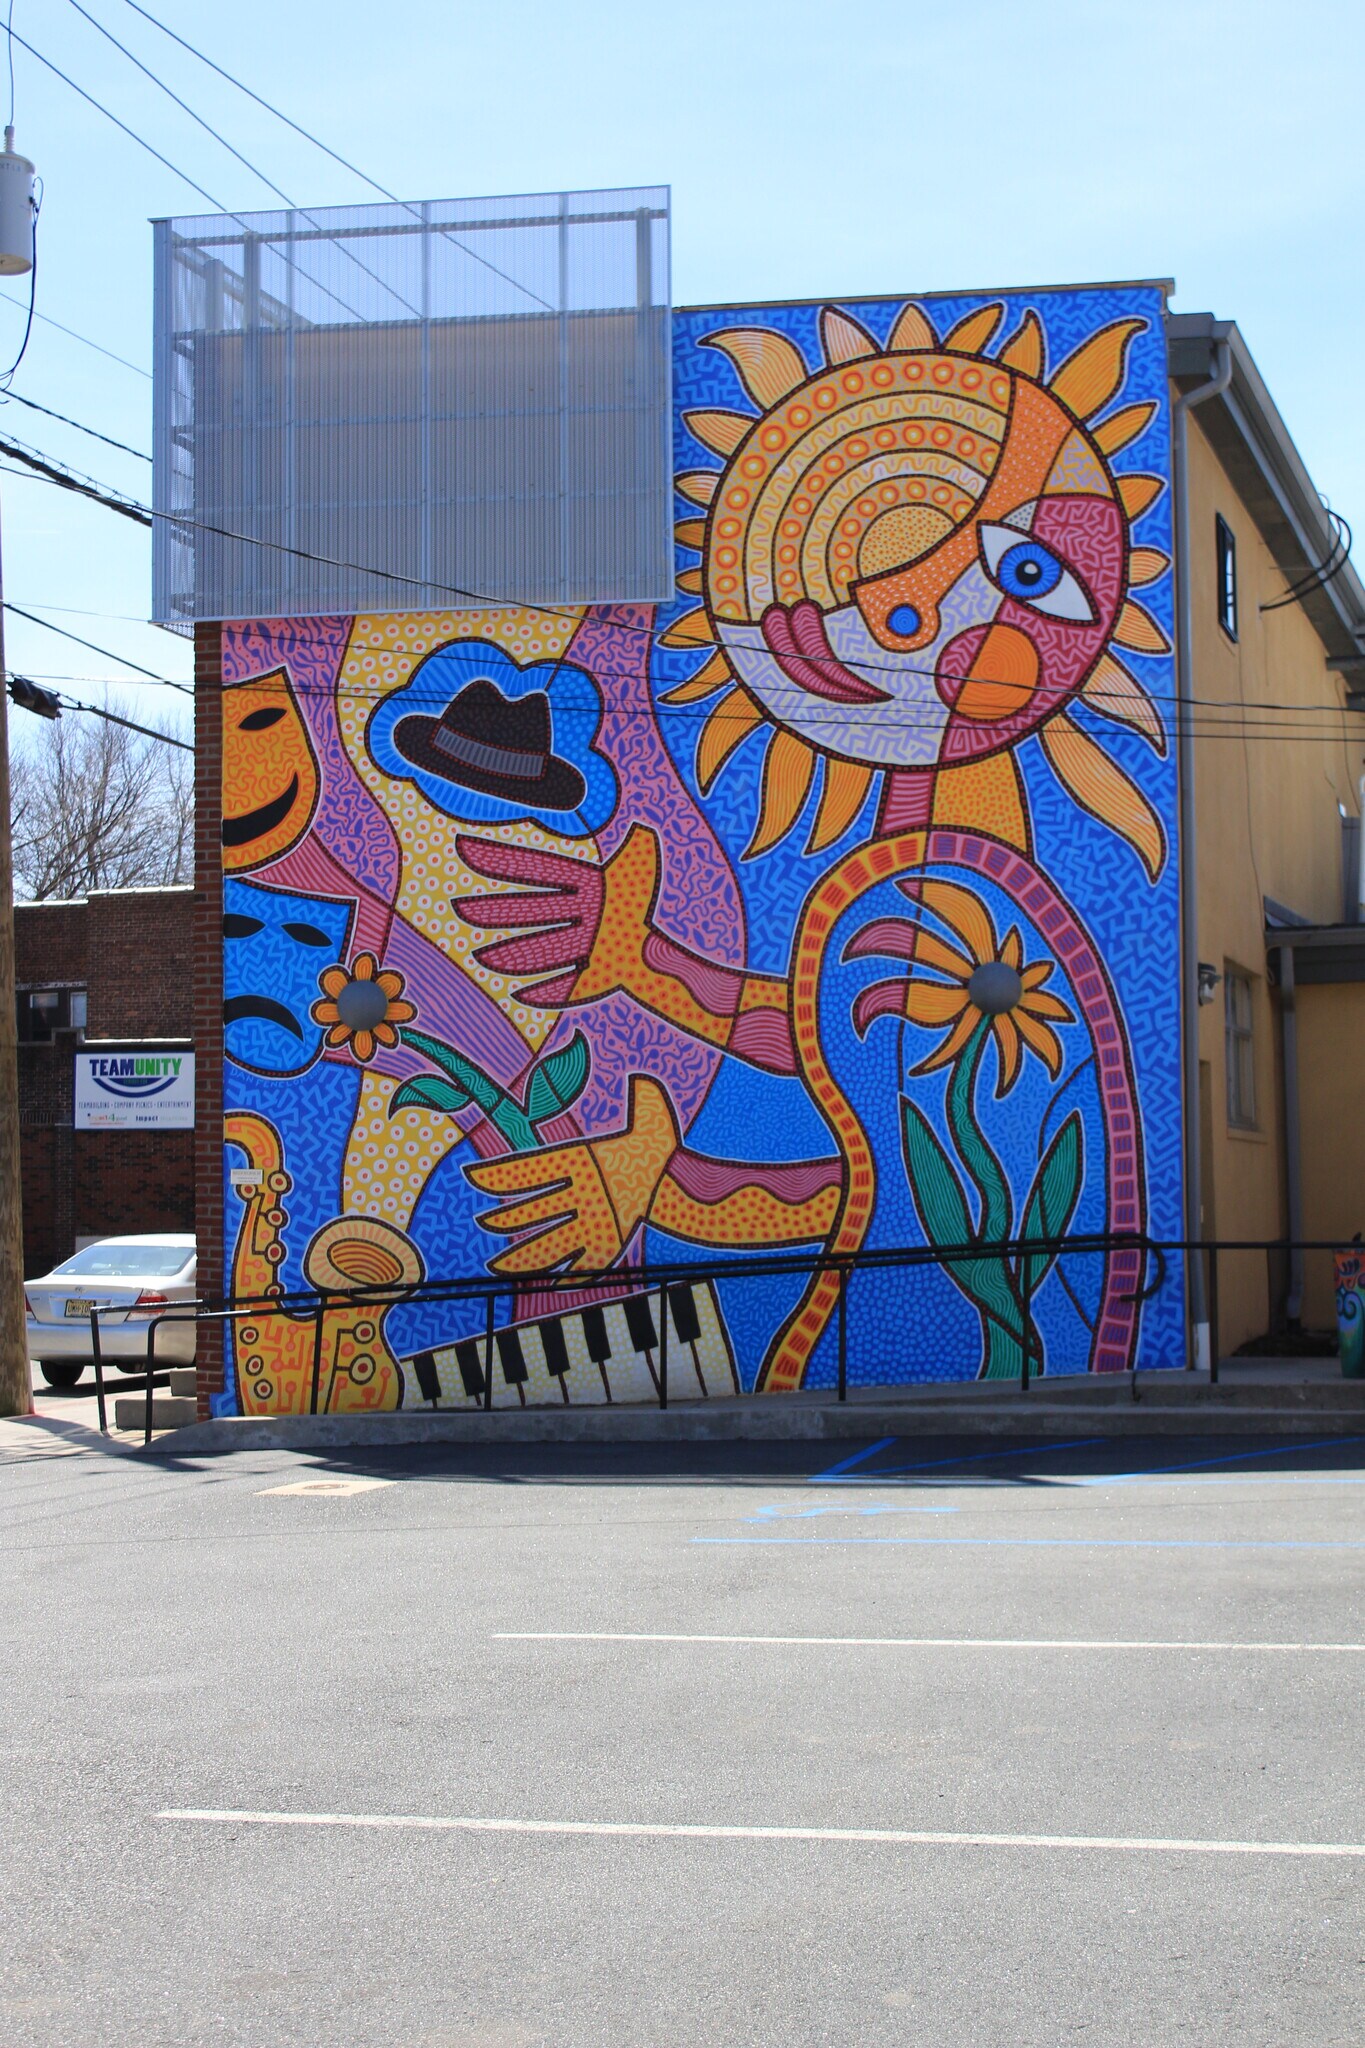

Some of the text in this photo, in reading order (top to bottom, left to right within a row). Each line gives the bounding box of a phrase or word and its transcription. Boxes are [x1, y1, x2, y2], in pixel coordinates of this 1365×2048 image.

[89, 1058, 182, 1076] TEAMUNITY
[230, 1068, 254, 1082] DAN
[256, 1077, 307, 1088] FENELON
[79, 1101, 110, 1109] TEAMBUILDING
[114, 1101, 135, 1109] COMPANY
